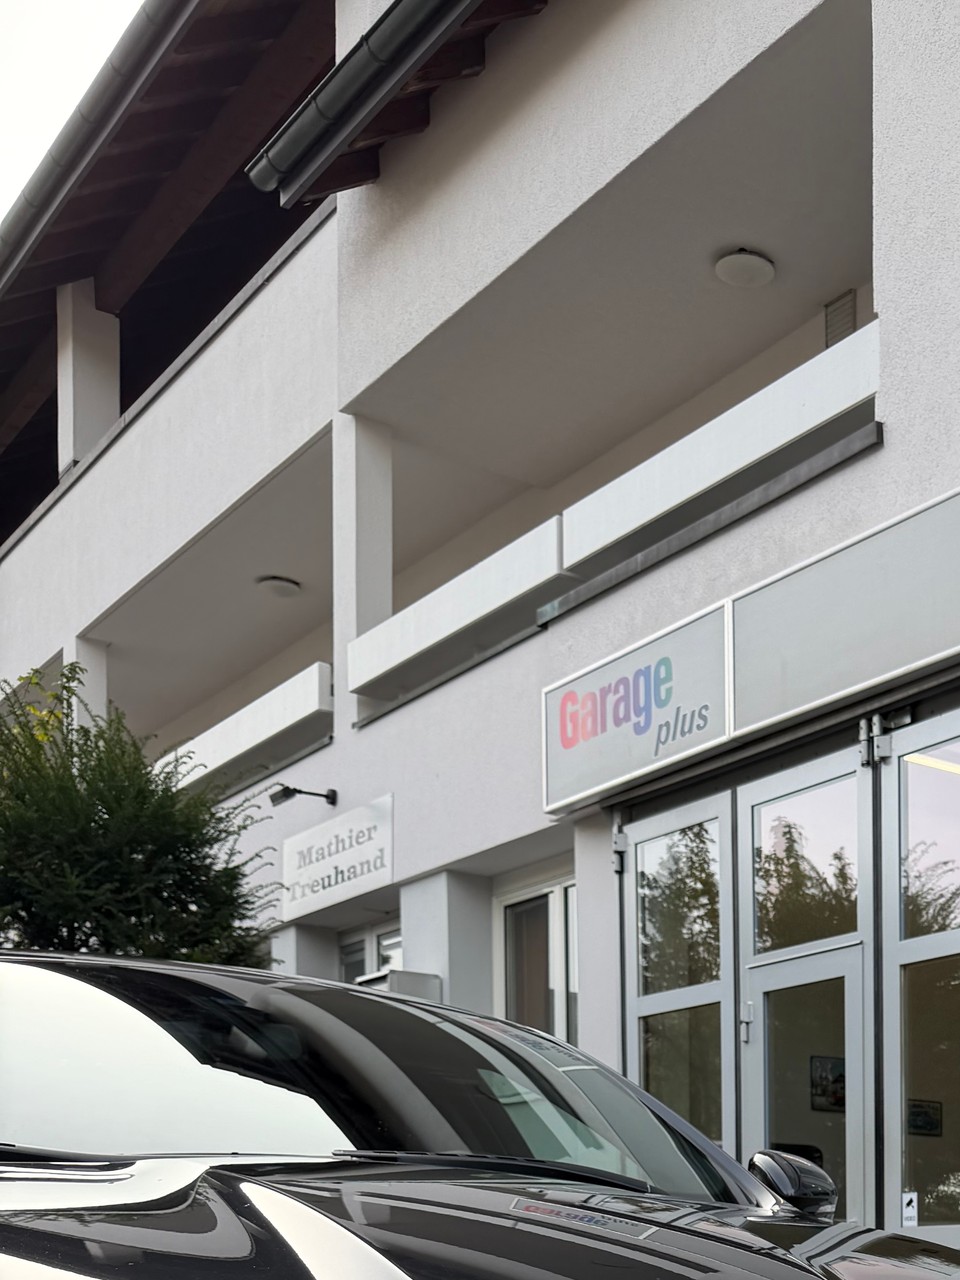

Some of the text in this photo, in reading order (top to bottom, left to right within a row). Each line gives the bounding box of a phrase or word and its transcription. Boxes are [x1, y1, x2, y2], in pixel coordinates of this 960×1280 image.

[558, 656, 674, 750] Garage
[653, 702, 710, 758] plus
[296, 824, 378, 870] Mathier
[289, 848, 387, 902] Treuhand
